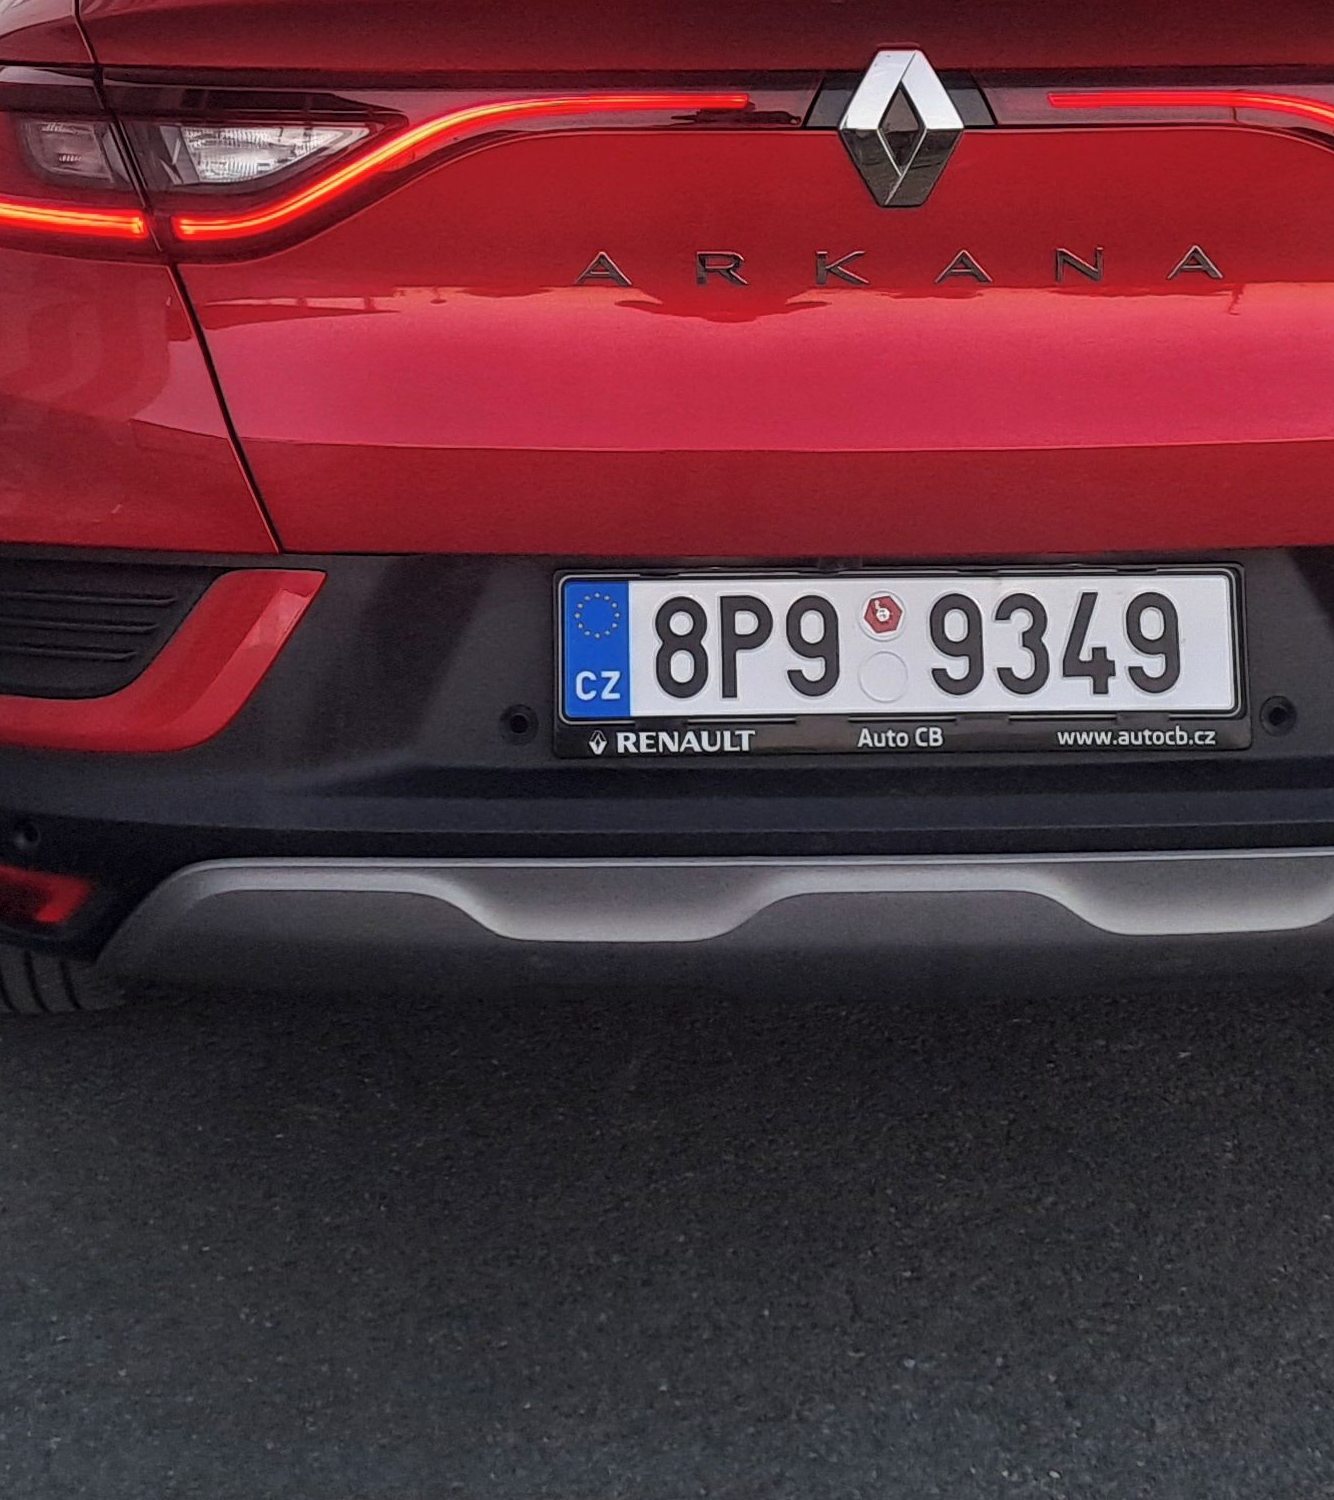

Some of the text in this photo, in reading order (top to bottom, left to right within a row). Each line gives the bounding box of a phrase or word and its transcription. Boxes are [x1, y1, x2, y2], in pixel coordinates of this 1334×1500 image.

[574, 244, 1223, 287] ARKANA
[654, 591, 1183, 700] 8P9 9349
[575, 670, 622, 702] CZ
[616, 726, 1217, 754] RENAULT Auto CB www.autocb.cz
